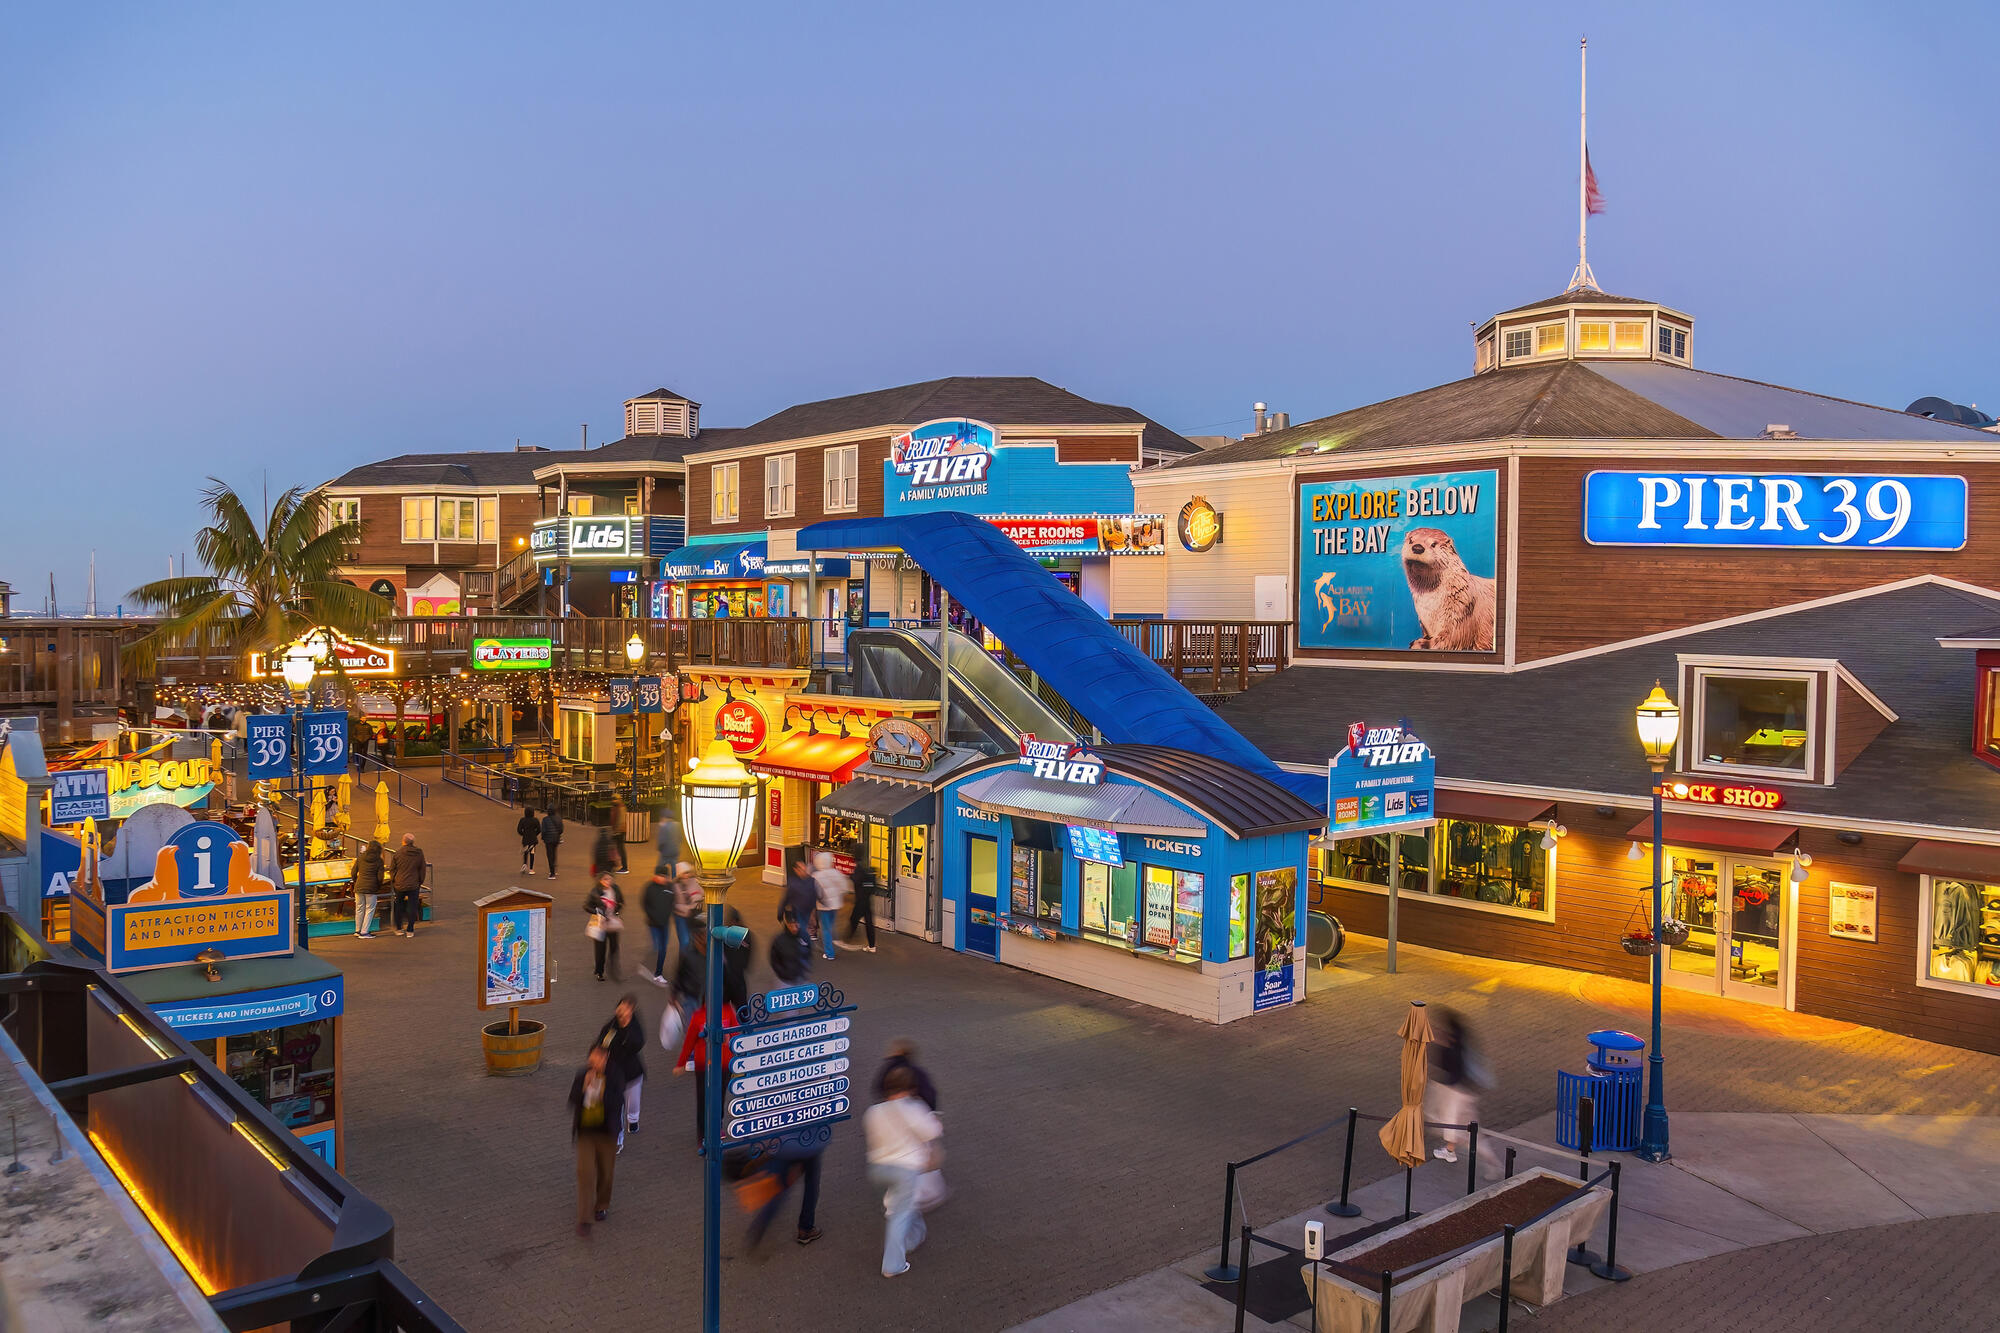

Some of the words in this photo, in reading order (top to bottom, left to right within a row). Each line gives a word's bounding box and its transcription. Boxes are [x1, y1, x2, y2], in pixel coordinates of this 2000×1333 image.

[904, 436, 952, 460] RIDE
[896, 462, 913, 473] THE
[912, 454, 987, 485] FLYER
[900, 491, 905, 501] A
[907, 487, 936, 501] FAMILY
[938, 483, 988, 499] ADVENTURE
[1312, 490, 1400, 521] EXPLORE
[1406, 485, 1479, 517] BELOW
[1638, 477, 1809, 531] PIER
[1818, 478, 1912, 545] 39
[573, 524, 625, 548] Lids
[1039, 526, 1085, 539] ROOMS
[1313, 527, 1348, 555] THE
[1352, 526, 1390, 555] BAY
[664, 562, 700, 580] AQUARIUM
[714, 560, 730, 575] BAY
[764, 565, 792, 575] VIRTUAL
[872, 559, 896, 571] NOW
[1339, 598, 1371, 615] BAY
[477, 648, 549, 660] PLAYERS
[641, 683, 658, 691] PIER
[612, 691, 630, 707] 39
[641, 691, 660, 706] 39
[252, 725, 285, 738] PIER
[309, 723, 341, 736] PIER
[725, 733, 739, 742] Coffee
[739, 735, 754, 744] Corner
[1365, 728, 1402, 746] RIDE
[252, 738, 287, 766] 39
[308, 735, 344, 763] 39
[1026, 741, 1069, 759] RIDE
[1357, 747, 1371, 757] THE
[1370, 743, 1425, 766] FLYER
[1019, 757, 1033, 766] THE
[1033, 759, 1099, 785] FLYER
[53, 773, 106, 798] ATM
[1355, 781, 1360, 789] A
[1361, 779, 1381, 788] FAMILY
[1382, 775, 1414, 786] ADVENTURE
[1661, 782, 1716, 803] RCK
[1723, 787, 1779, 808] SHOP
[57, 800, 104, 811] CASH
[57, 807, 105, 817] MACHINE
[1336, 801, 1358, 811] ESCAPE
[1387, 798, 1404, 811] Lids
[821, 806, 838, 815] Whale
[840, 809, 866, 822] Watching
[868, 814, 885, 824] Tours
[956, 806, 1000, 823] TICKETS
[1337, 810, 1357, 820] ROOMS
[1143, 836, 1202, 857] TICKETS
[1148, 902, 1158, 910] WE
[1148, 910, 1167, 919] OPEN
[130, 912, 217, 929] ATTRACTION
[224, 906, 275, 920] TICKETS
[130, 930, 161, 941] AND
[170, 919, 275, 938] INFORMATION
[1264, 981, 1282, 990] Soar
[770, 993, 800, 1009] PIER
[801, 989, 815, 1004] 39
[177, 1012, 213, 1022] TICKETS
[216, 1010, 237, 1019] AND
[240, 1001, 301, 1016] INFORMATION
[756, 1033, 779, 1047] FOG
[782, 1024, 827, 1042] HARBOR
[760, 1051, 795, 1066] EAGLE
[797, 1044, 825, 1058] CAFE
[757, 1073, 786, 1088] CRAB
[789, 1064, 826, 1080] HOUSE
[745, 1091, 797, 1112] WELCOME
[798, 1082, 834, 1100] CENTER
[750, 1117, 784, 1132] LEVEL
[787, 1113, 794, 1124] 2
[796, 1103, 832, 1121] SHOPS
